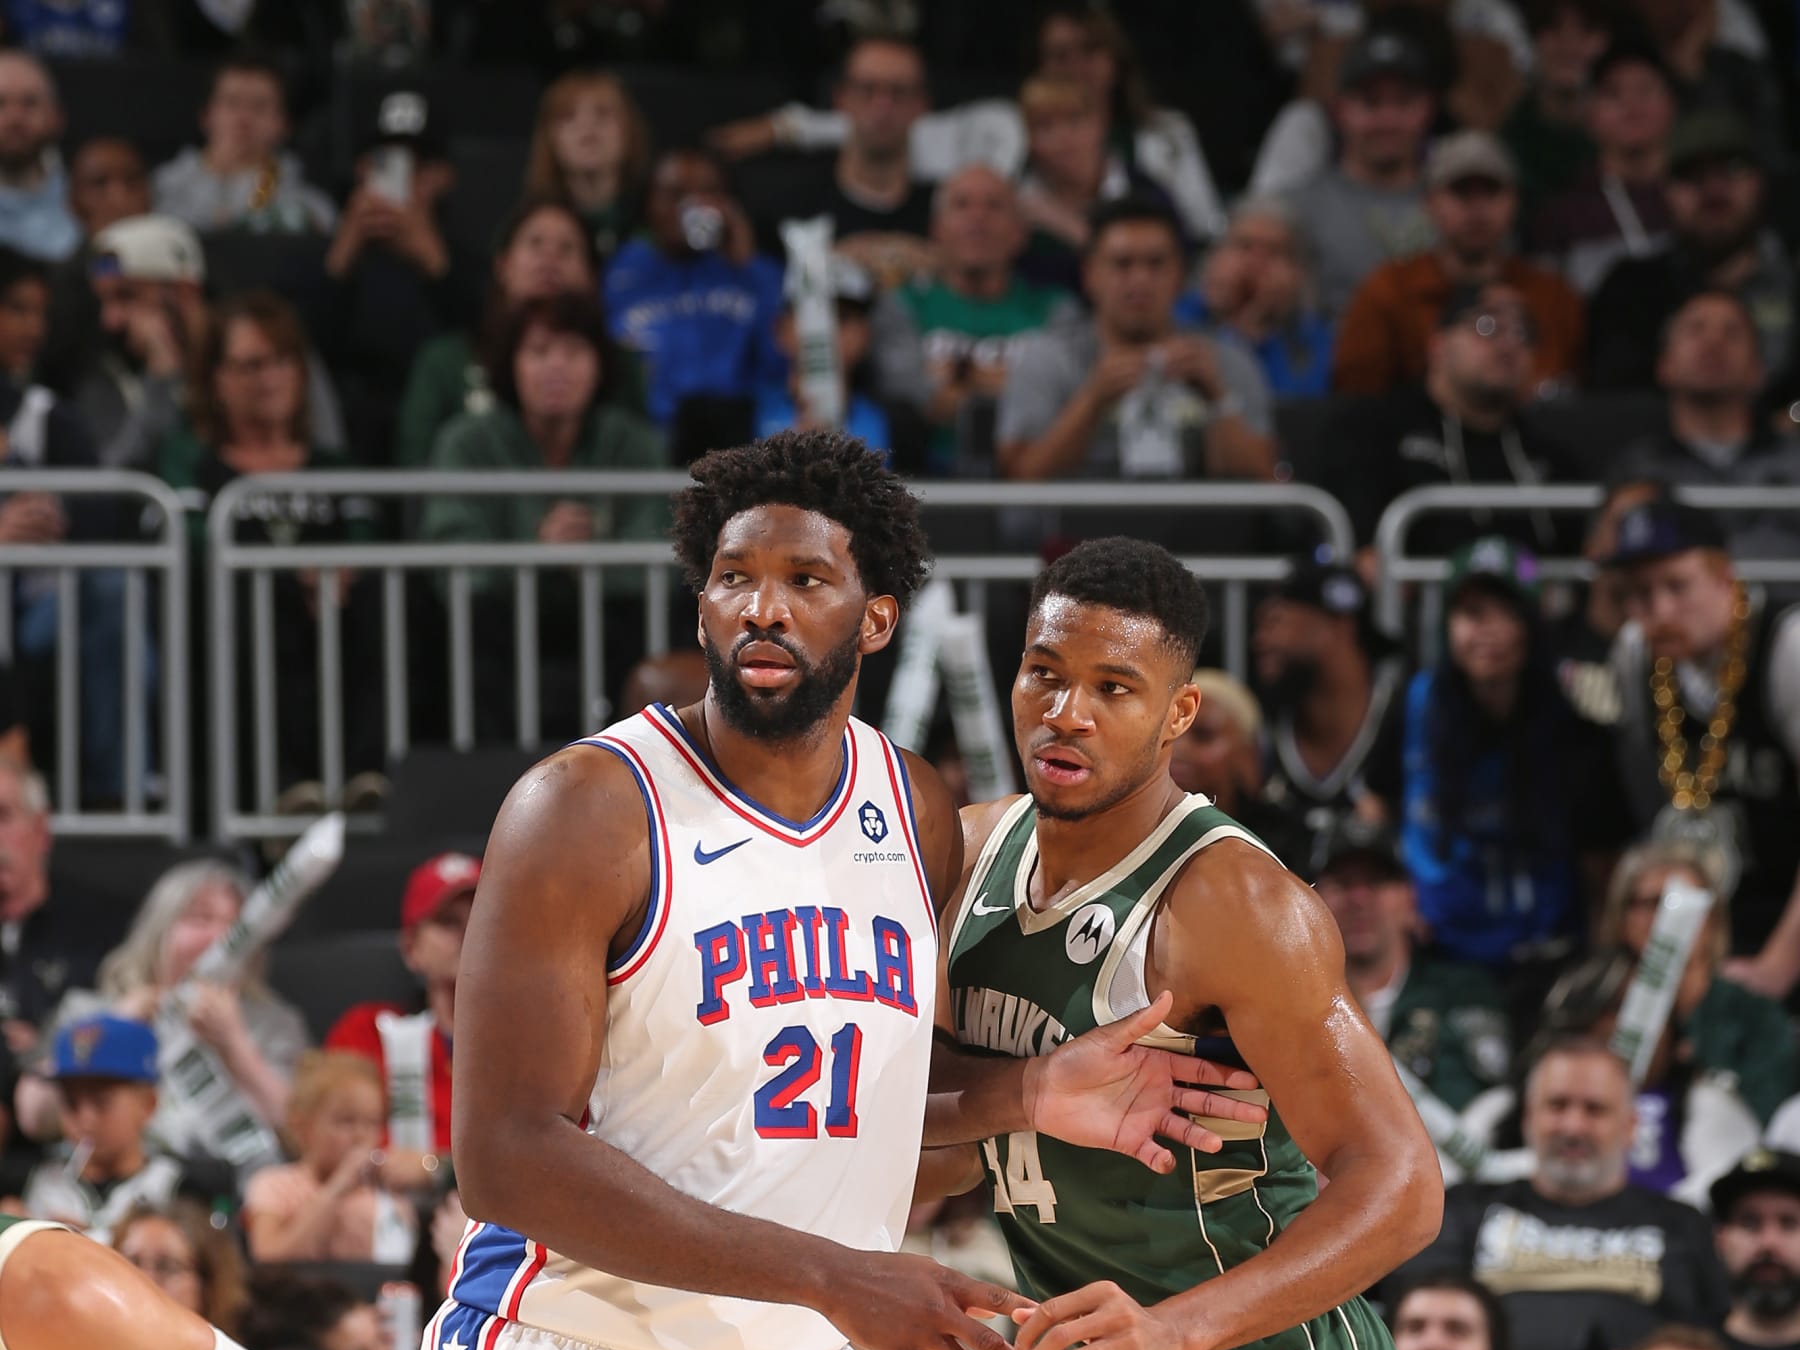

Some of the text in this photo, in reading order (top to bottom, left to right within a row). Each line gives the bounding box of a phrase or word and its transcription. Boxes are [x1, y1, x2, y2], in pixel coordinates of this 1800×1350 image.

[853, 851, 906, 864] crypto.com
[693, 905, 919, 1027] PHILA
[753, 1022, 864, 1140] 21
